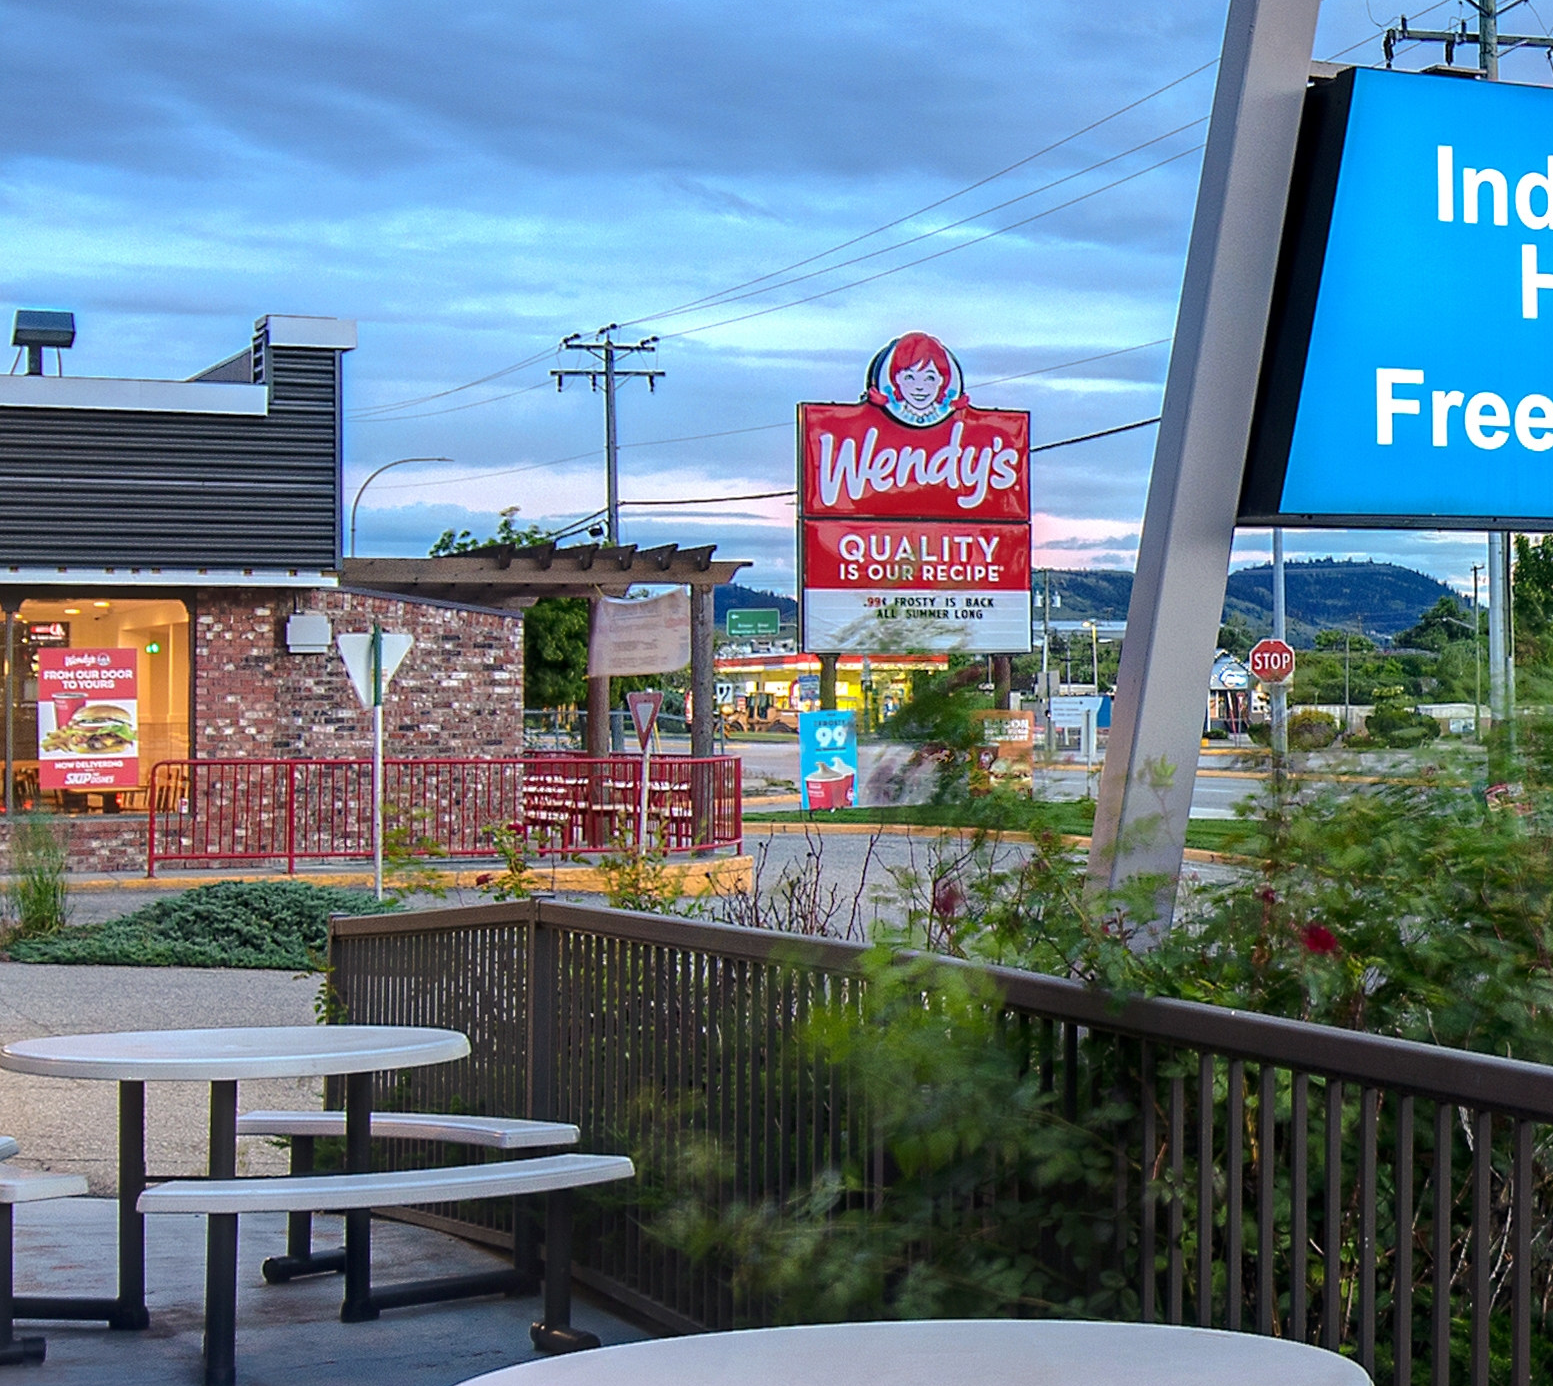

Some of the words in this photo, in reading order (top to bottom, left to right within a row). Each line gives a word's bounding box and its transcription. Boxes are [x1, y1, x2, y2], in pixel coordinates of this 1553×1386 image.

[818, 420, 1020, 510] Wendy's
[838, 534, 1000, 563] QUALITY
[839, 563, 858, 581] IS
[867, 563, 913, 582] OUR
[922, 564, 1000, 582] RECIPE
[894, 597, 937, 607] FROSTY
[945, 597, 957, 607] IS
[965, 597, 995, 608] BACK
[876, 609, 897, 619] ALL
[905, 609, 950, 619] SUMMER
[954, 609, 984, 619] LONG
[1254, 652, 1291, 670] STOP
[43, 670, 75, 680] FROM
[76, 670, 99, 680] OUR
[101, 669, 133, 679] DOOR
[62, 680, 78, 689] TO
[79, 679, 115, 689] YOURS
